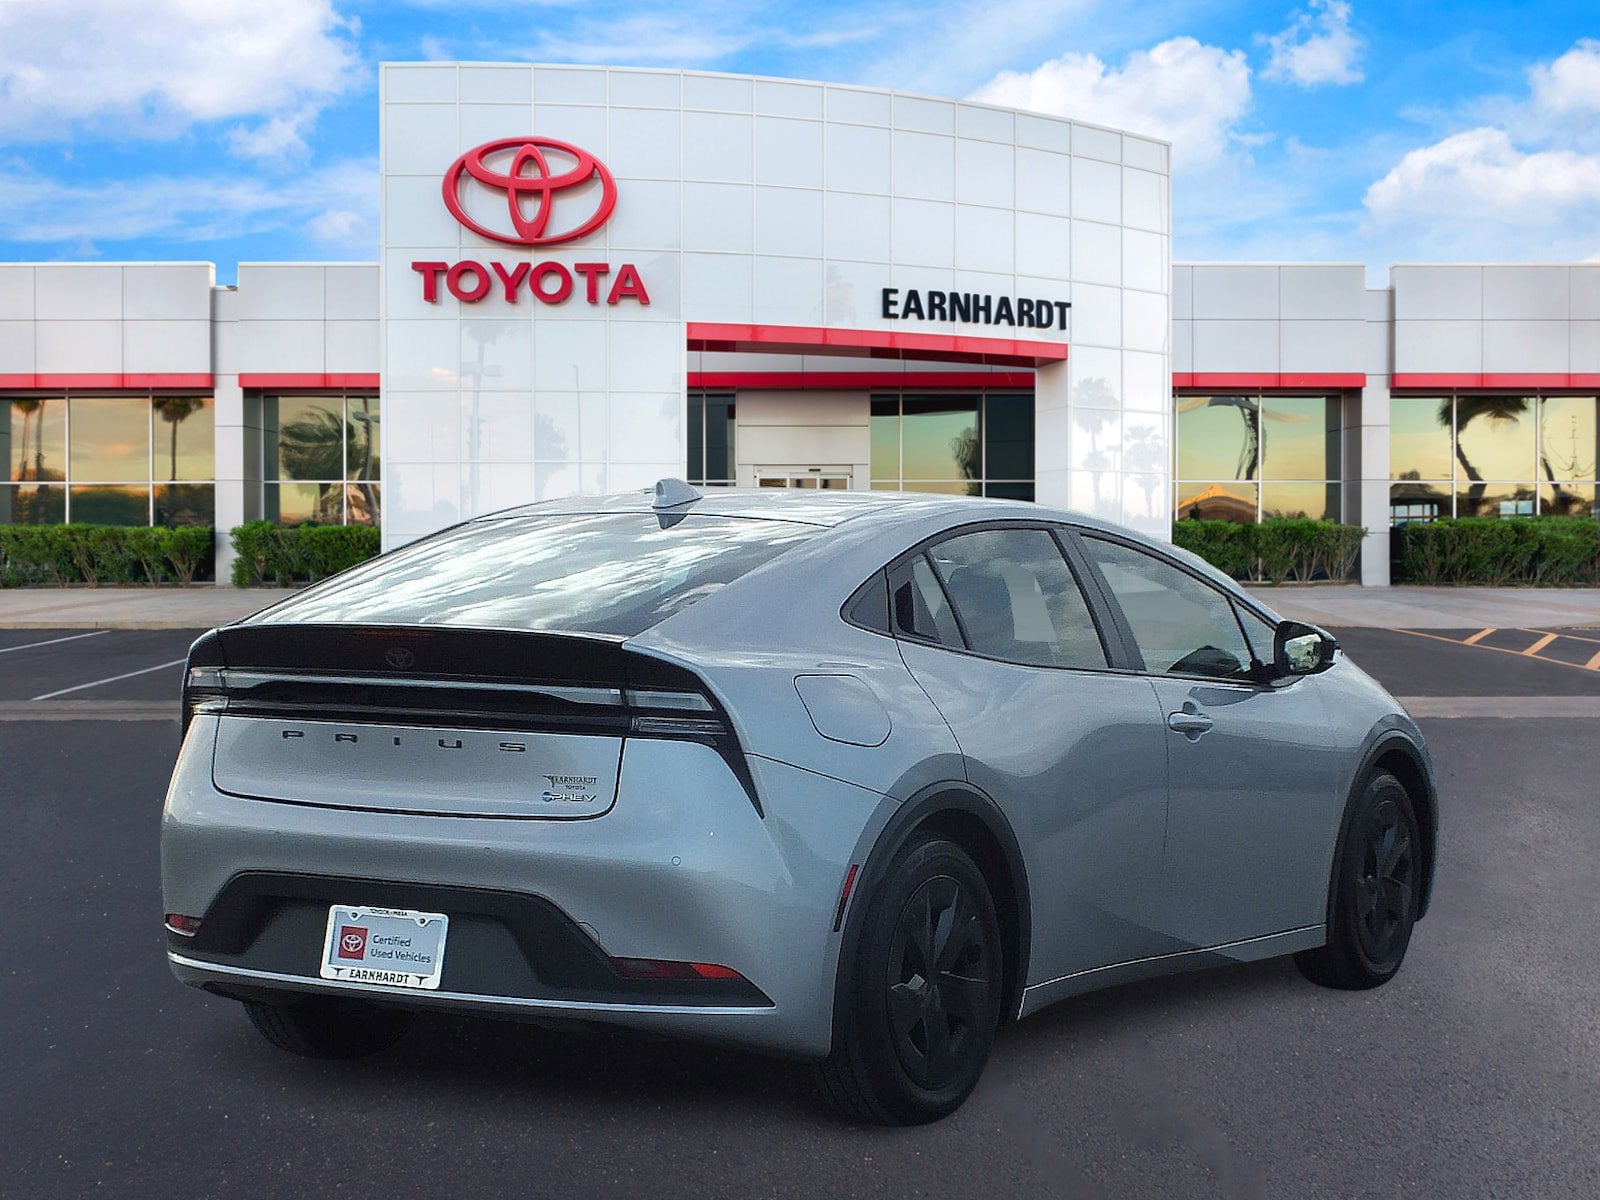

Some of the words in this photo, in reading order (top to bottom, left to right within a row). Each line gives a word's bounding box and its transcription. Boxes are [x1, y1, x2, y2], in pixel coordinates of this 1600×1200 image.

[412, 261, 650, 305] TOYOTA
[882, 287, 1071, 330] EARNHARDT
[283, 731, 526, 752] PRIUS
[373, 935, 411, 947] Certified
[371, 948, 393, 960] Used
[394, 950, 431, 963] Vehicles
[349, 969, 410, 984] EARNHARDT
